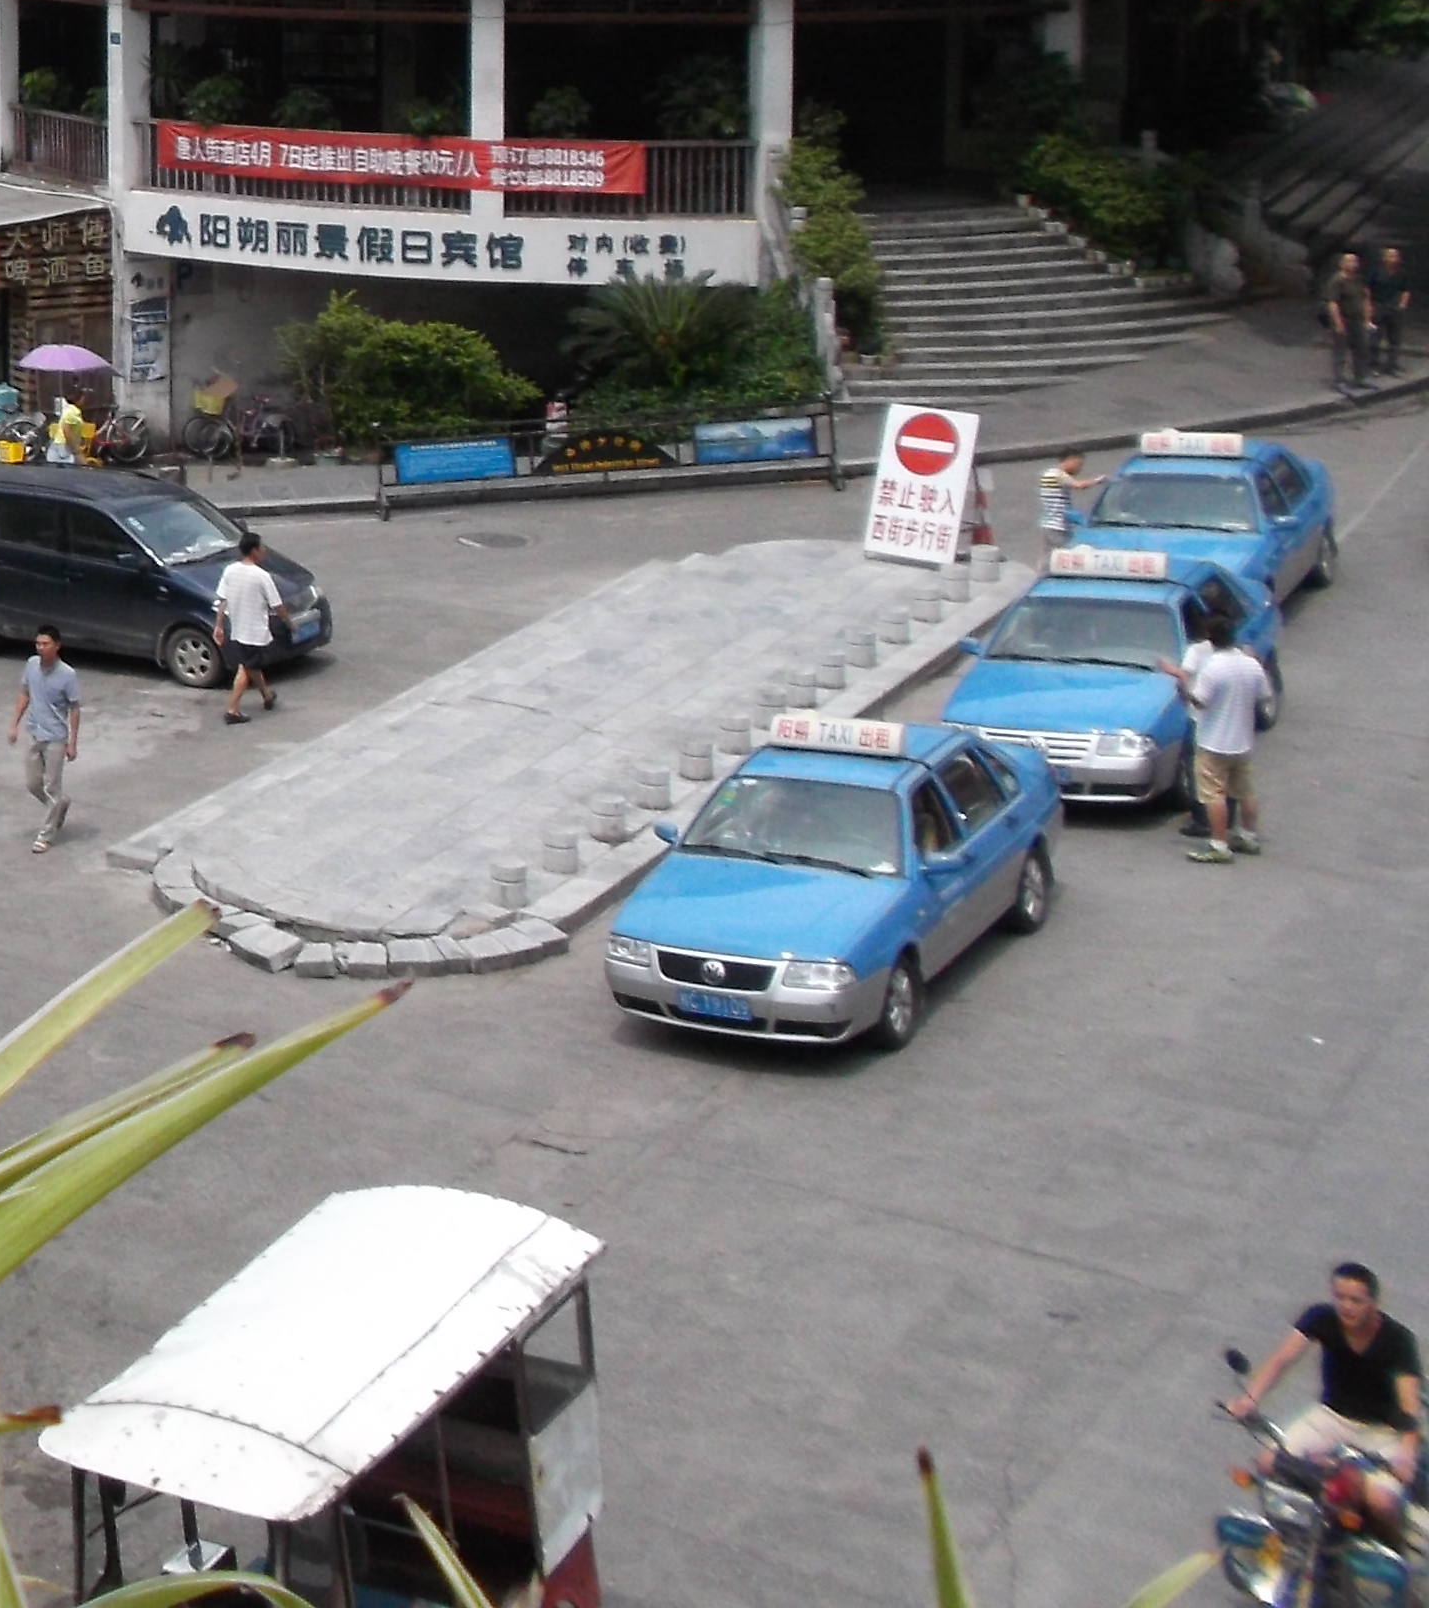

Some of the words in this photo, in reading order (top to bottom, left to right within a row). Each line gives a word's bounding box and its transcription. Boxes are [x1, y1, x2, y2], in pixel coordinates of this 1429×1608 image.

[0, 215, 108, 258] 大师傅
[199, 211, 526, 270] 阳朔丽景假日宾馆
[3, 253, 106, 287] 啤酒鱼
[877, 477, 957, 516] 禁止驶入
[871, 513, 954, 554] 西街步行街
[818, 721, 855, 745] TAXI
[858, 725, 891, 749] 出租
